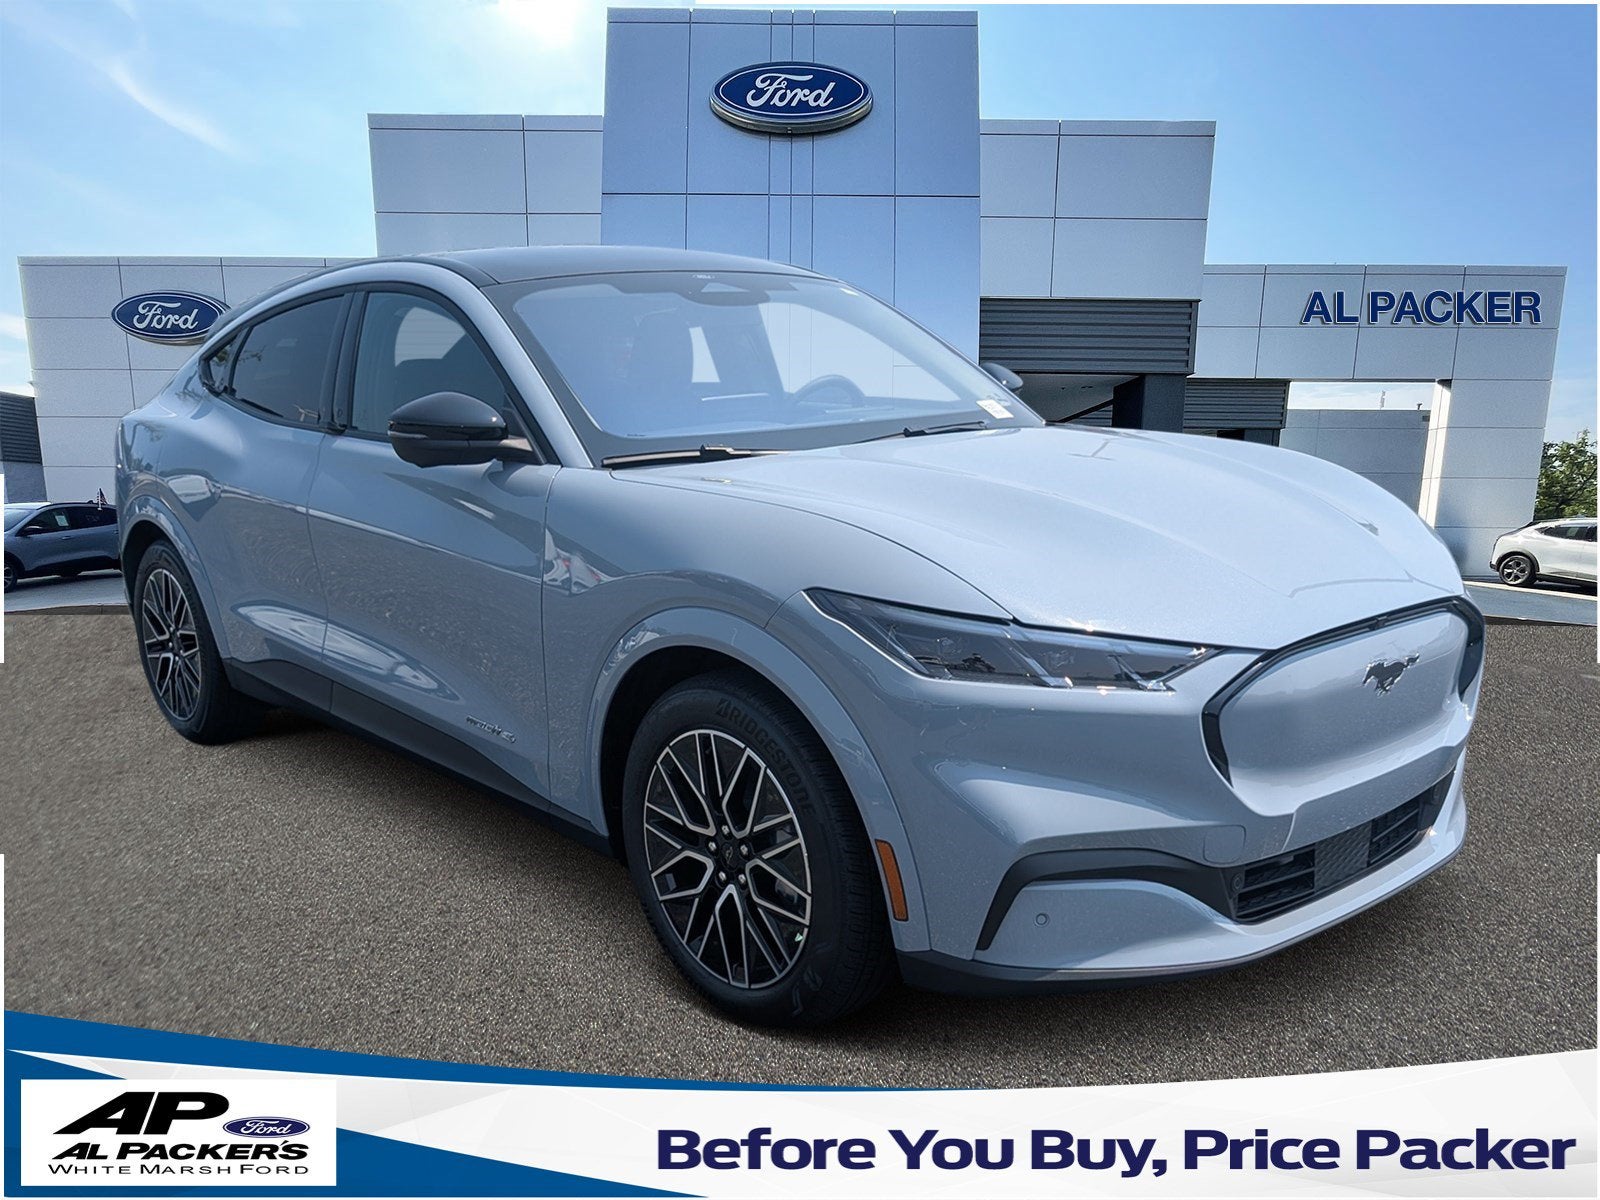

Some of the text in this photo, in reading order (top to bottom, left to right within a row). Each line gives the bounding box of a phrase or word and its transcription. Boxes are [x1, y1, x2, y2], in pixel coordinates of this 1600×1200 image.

[746, 73, 836, 107] Ford
[133, 301, 198, 329] Ford
[1301, 290, 1543, 325] AL PACKER
